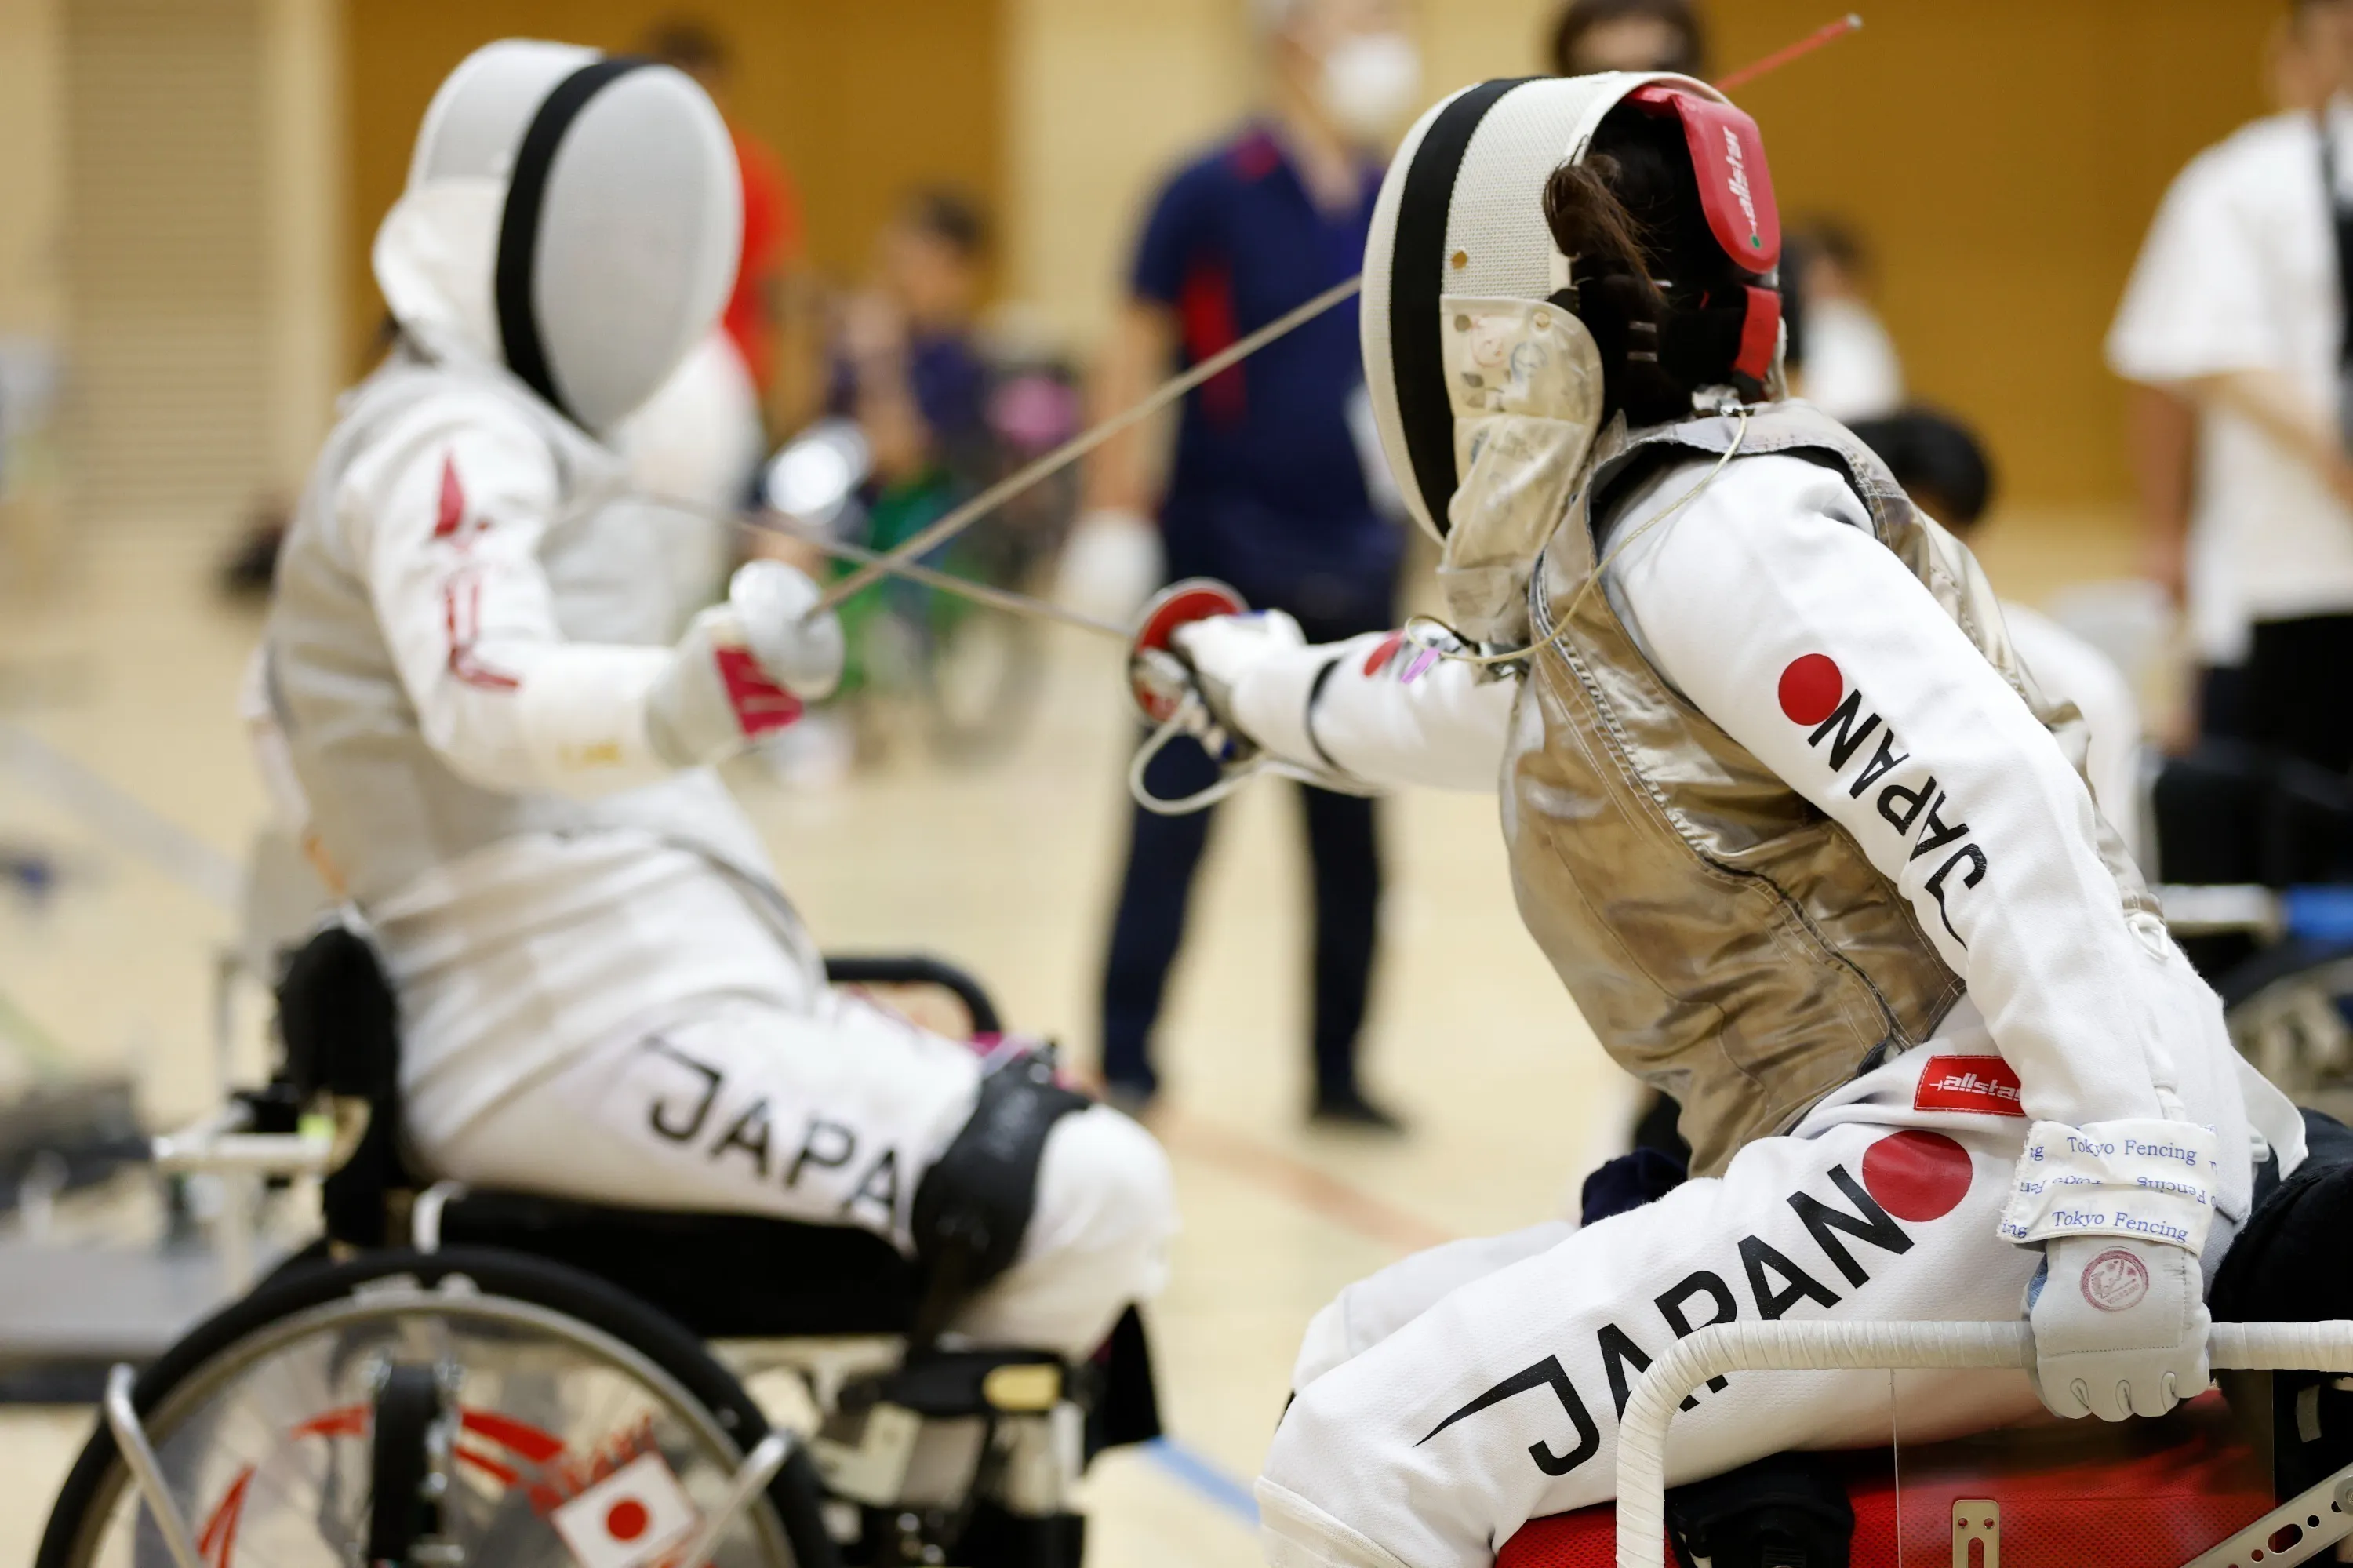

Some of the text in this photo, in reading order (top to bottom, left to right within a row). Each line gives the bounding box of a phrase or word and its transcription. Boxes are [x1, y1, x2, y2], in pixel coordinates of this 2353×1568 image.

[1807, 688, 1988, 952] JAPAN
[2066, 1137, 2115, 1157] Tokyo
[2124, 1139, 2198, 1166] Fencing
[2052, 1210, 2104, 1227] Tokyo
[2113, 1212, 2188, 1243] Fencing
[1413, 1163, 1915, 1477] JAPAN
